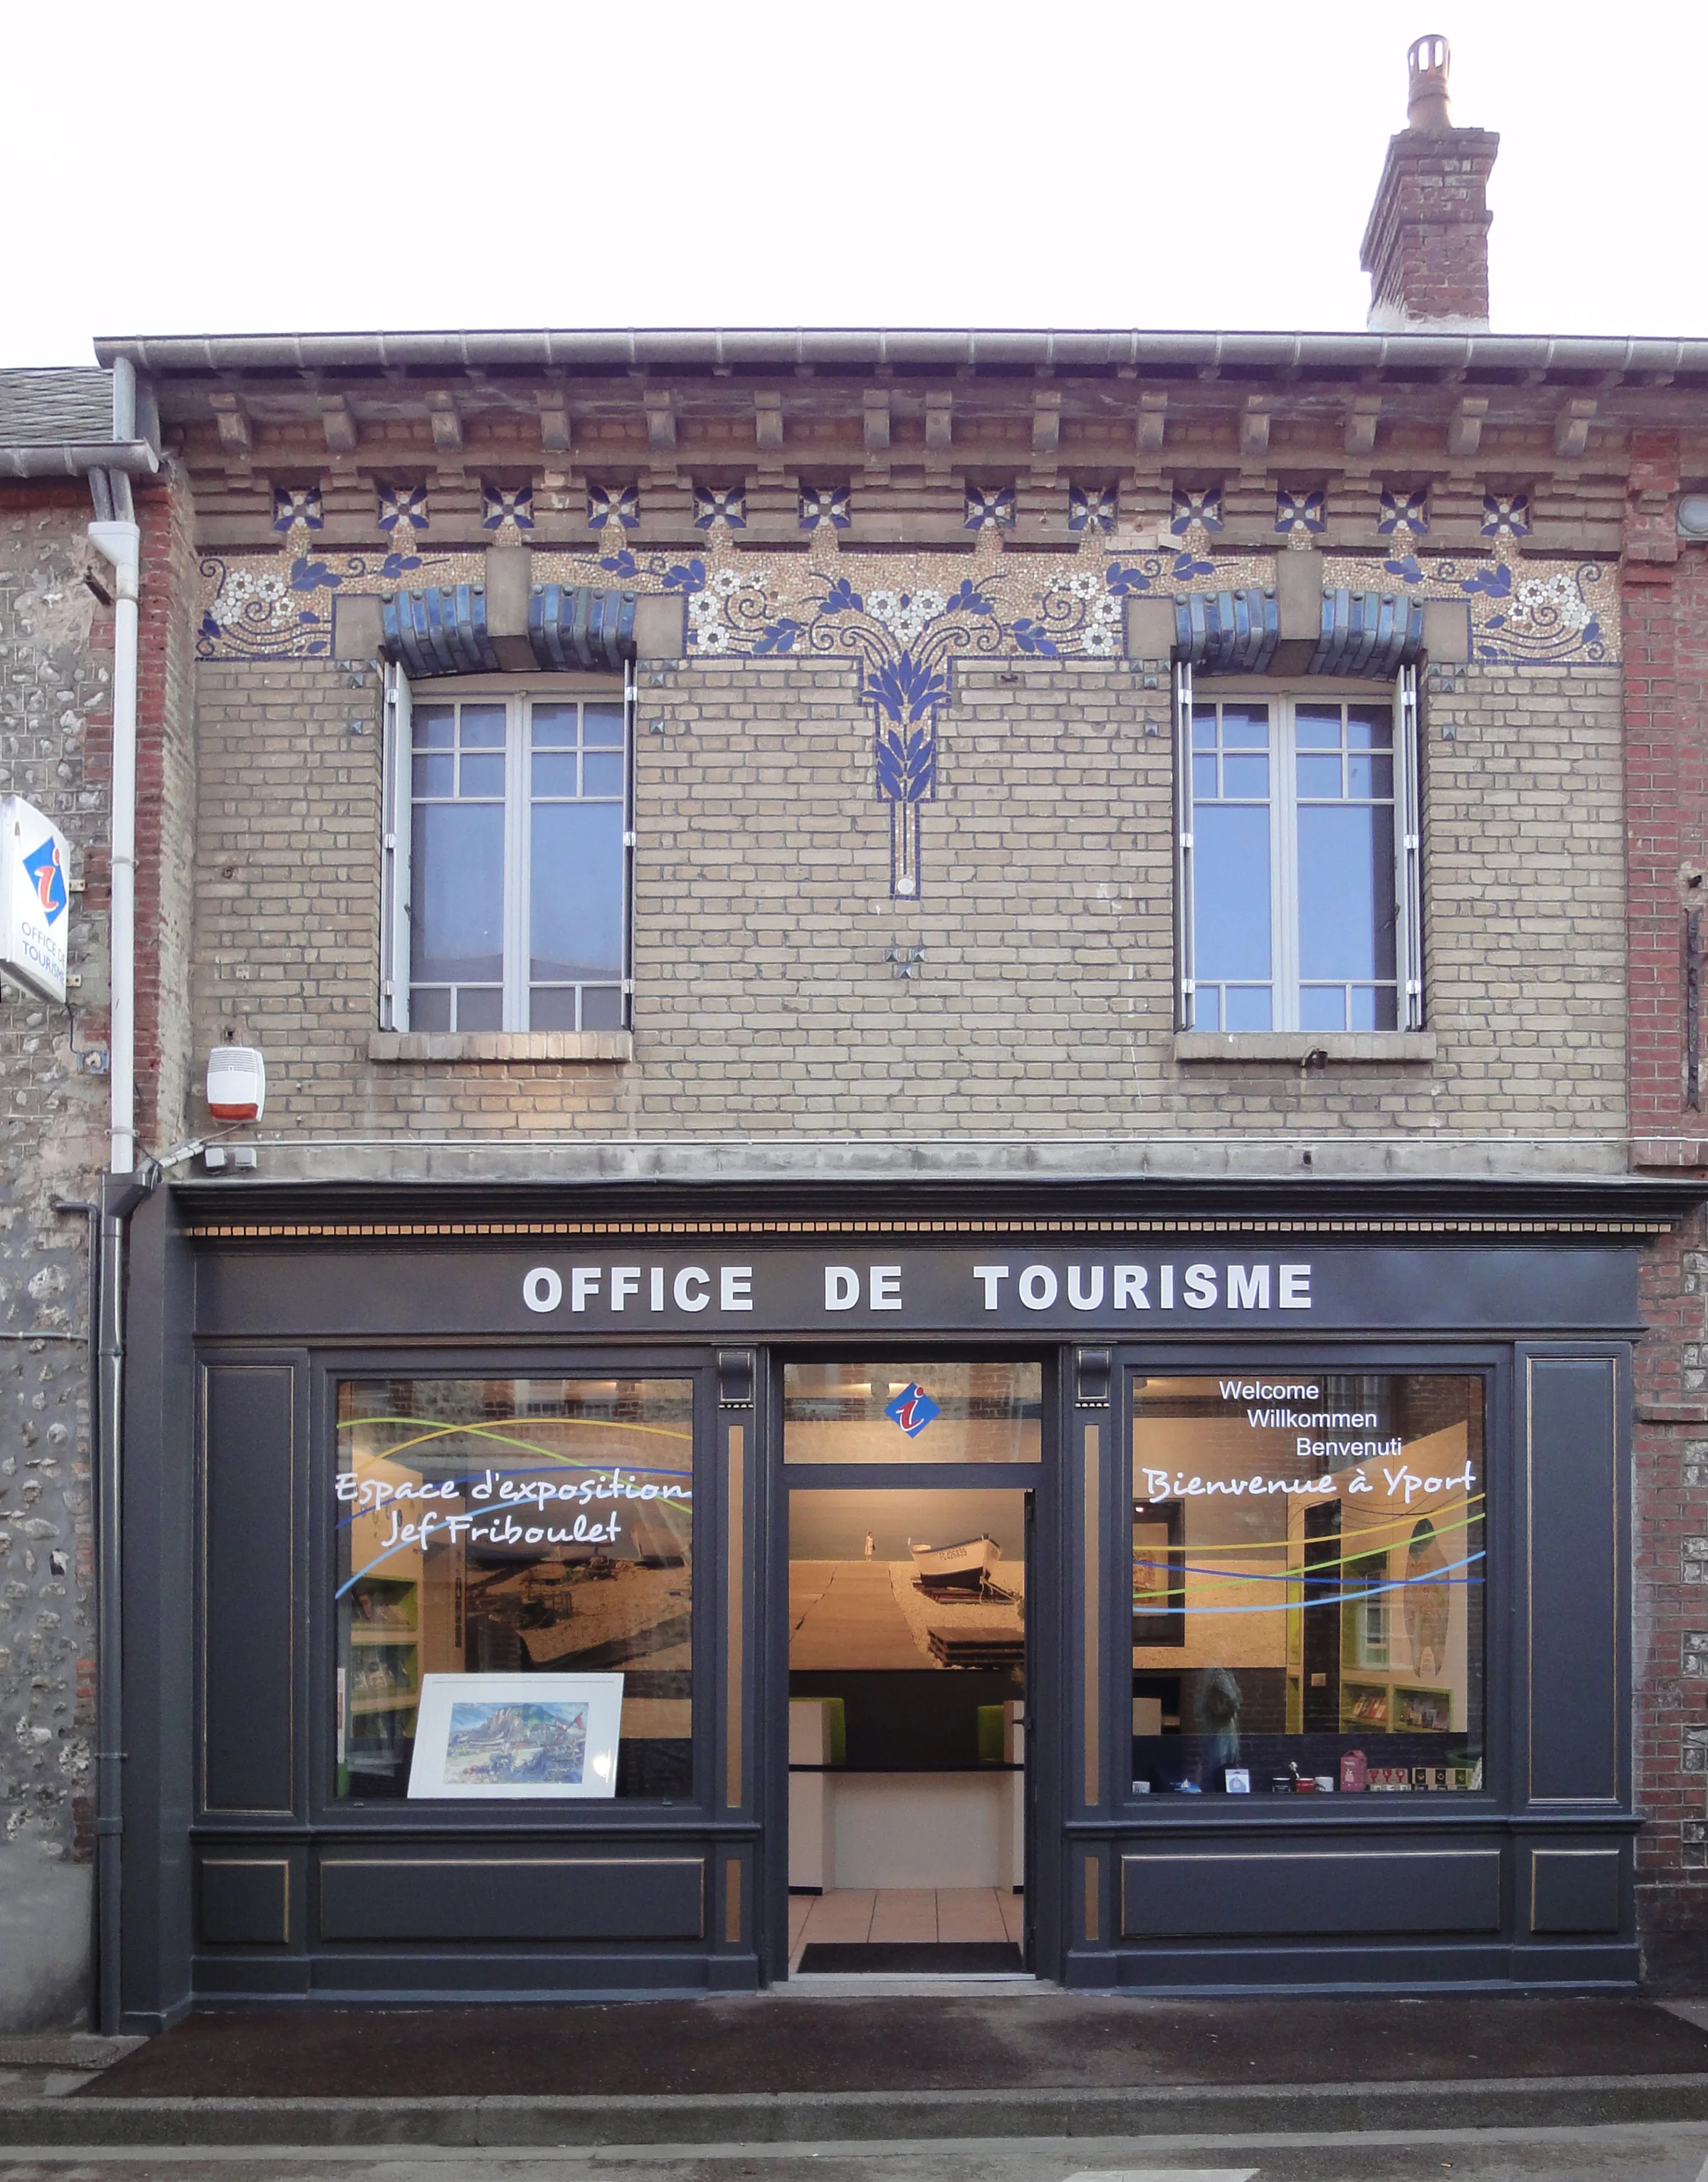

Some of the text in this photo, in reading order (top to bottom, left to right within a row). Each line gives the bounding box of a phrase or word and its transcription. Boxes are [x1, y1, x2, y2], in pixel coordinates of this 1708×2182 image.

[21, 922, 56, 956] OFFICE
[22, 940, 65, 986] TOURISME
[522, 1264, 1312, 1312] OFFICE DE TOURISME
[1218, 1381, 1319, 1400] Welcome
[1247, 1408, 1378, 1428] Willkommen
[1296, 1438, 1403, 1456] Benvenuti
[335, 1468, 693, 1511] Espace d'exposition
[1142, 1460, 1477, 1504] Bienvenue à Yport
[381, 1510, 622, 1550] Jef Friboulet
